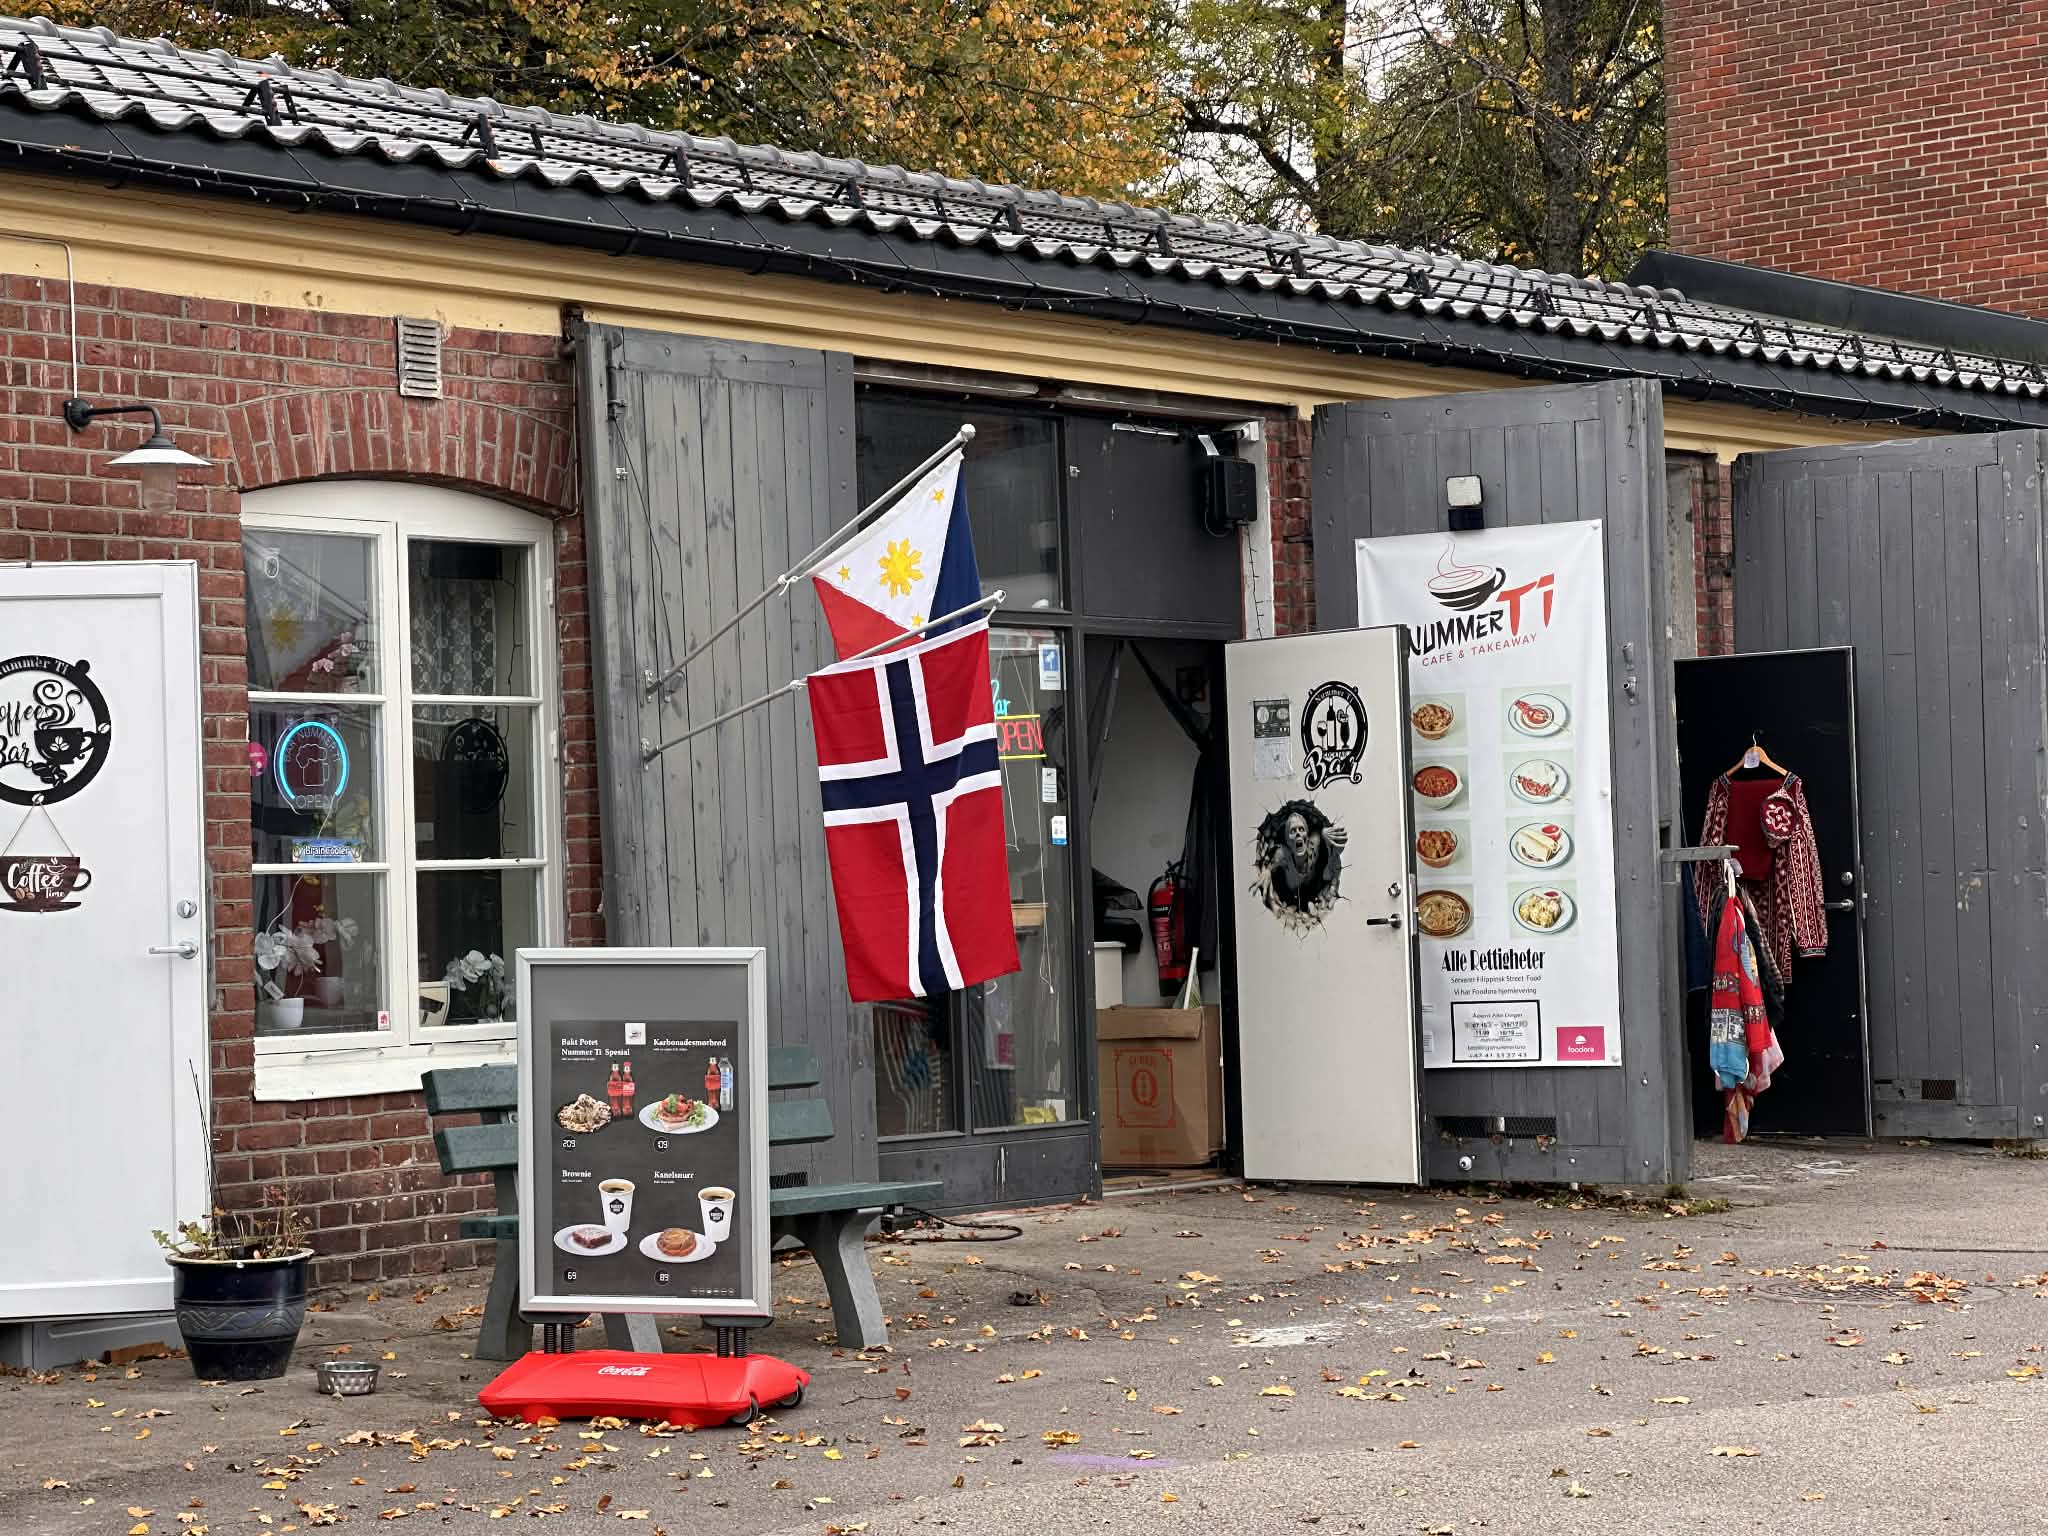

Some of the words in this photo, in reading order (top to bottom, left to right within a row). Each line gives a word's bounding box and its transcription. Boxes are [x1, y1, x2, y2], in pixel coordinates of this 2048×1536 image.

[1409, 609, 1504, 655] NUMMER
[1421, 653, 1455, 667] CAFE
[1458, 650, 1465, 659] &
[1471, 632, 1538, 656] TAKEAWAY
[0, 656, 49, 675] ummer
[0, 701, 45, 737] offee
[996, 719, 1044, 752] OPEN
[1303, 746, 1362, 790] Bar
[8, 863, 64, 892] Coffee
[1441, 949, 1467, 972] Alle
[1470, 948, 1546, 971] Rettigheter
[1506, 974, 1524, 982] Street
[1526, 974, 1542, 982] Food
[561, 1048, 593, 1056] Nummer
[594, 1048, 602, 1056] Ti
[604, 1048, 630, 1058] Spesial
[1567, 1045, 1595, 1053] foodora
[562, 1139, 576, 1148] 209
[561, 1169, 592, 1178] Brownie
[567, 1271, 577, 1280] 69
[598, 1365, 652, 1376] Coca-Cola
